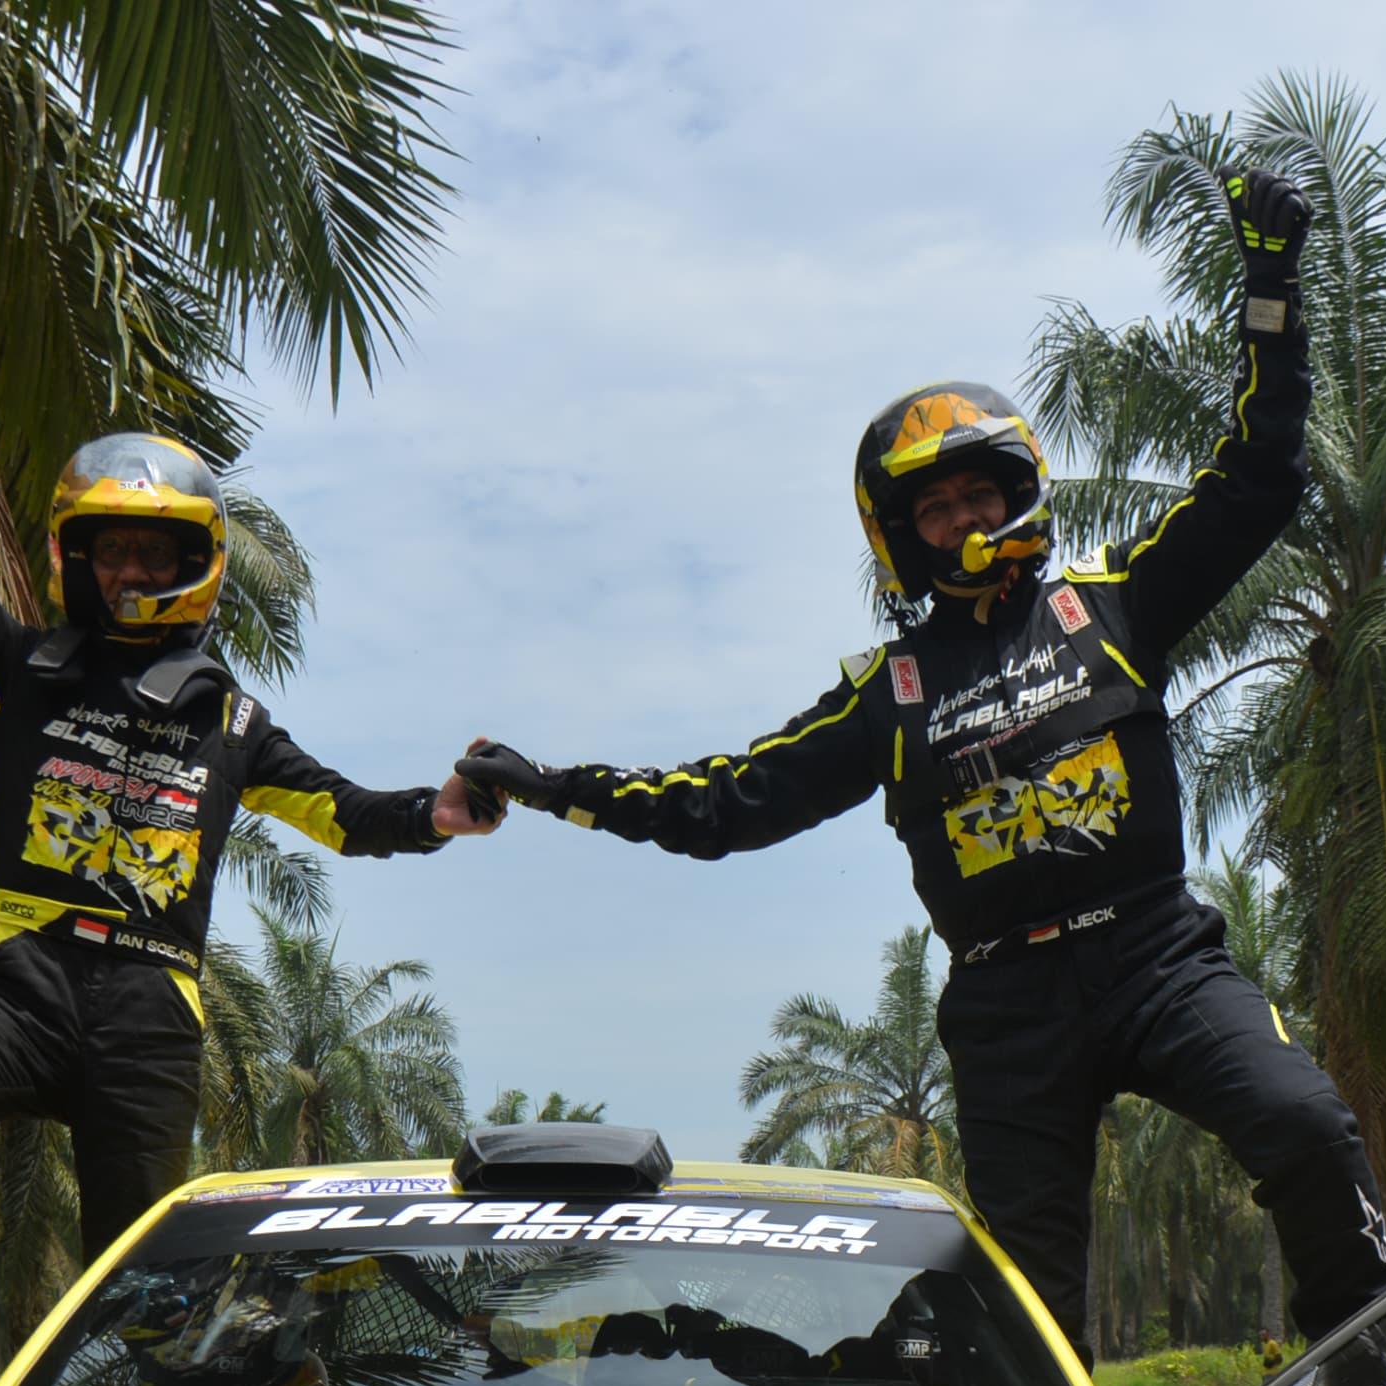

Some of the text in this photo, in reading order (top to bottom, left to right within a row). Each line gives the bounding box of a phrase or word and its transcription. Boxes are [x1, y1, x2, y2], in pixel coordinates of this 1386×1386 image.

[1068, 905, 1117, 931] IJECK
[115, 931, 144, 950] IAN
[247, 1202, 878, 1240] BLABLABLA
[492, 1223, 878, 1255] MOTORSPORT
[894, 1341, 931, 1357] OMP
